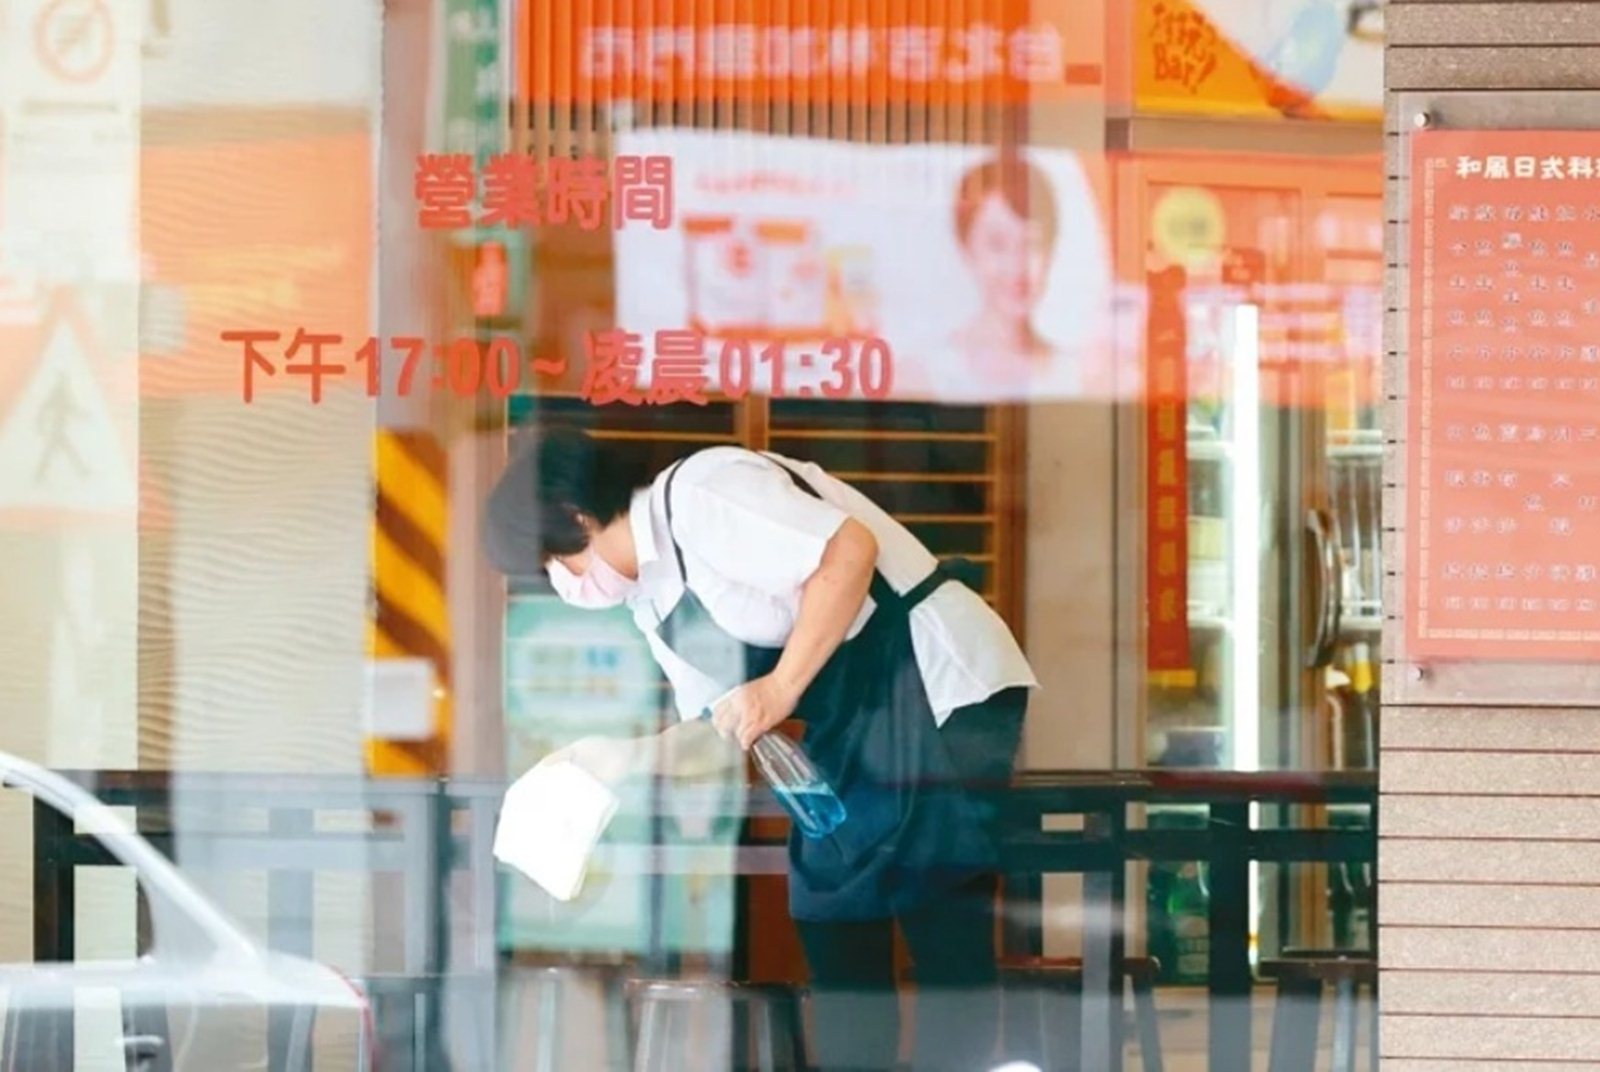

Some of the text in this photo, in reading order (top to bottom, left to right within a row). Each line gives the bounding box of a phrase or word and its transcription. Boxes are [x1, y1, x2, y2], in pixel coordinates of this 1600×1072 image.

[415, 153, 674, 230] 營業時間
[1456, 155, 1600, 180] 和風日式料
